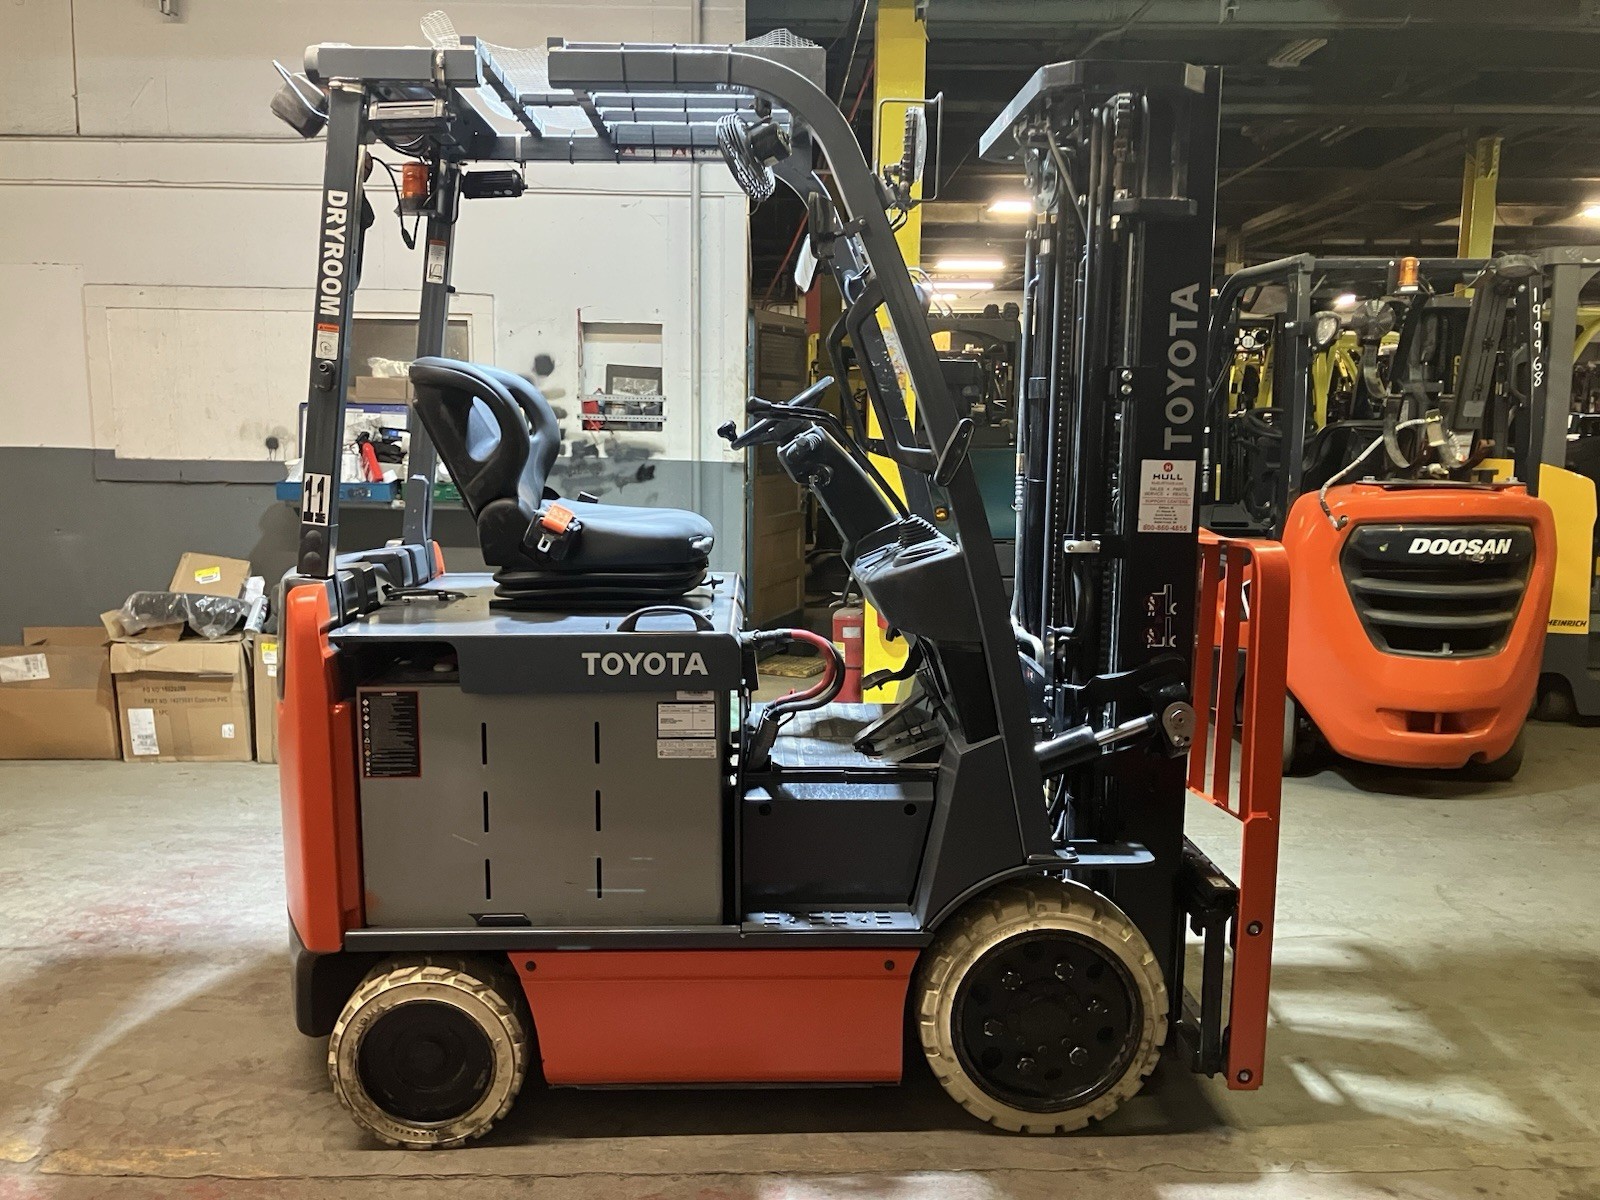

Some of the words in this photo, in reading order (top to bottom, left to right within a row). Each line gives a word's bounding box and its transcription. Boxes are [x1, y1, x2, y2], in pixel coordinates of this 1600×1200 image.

[319, 189, 349, 317] DRYROOM
[1163, 282, 1200, 451] TOYOTA
[1532, 287, 1544, 387] 199968
[303, 475, 326, 524] 11
[1408, 538, 1512, 555] DOOSAN
[581, 652, 709, 676] TOYOTA
